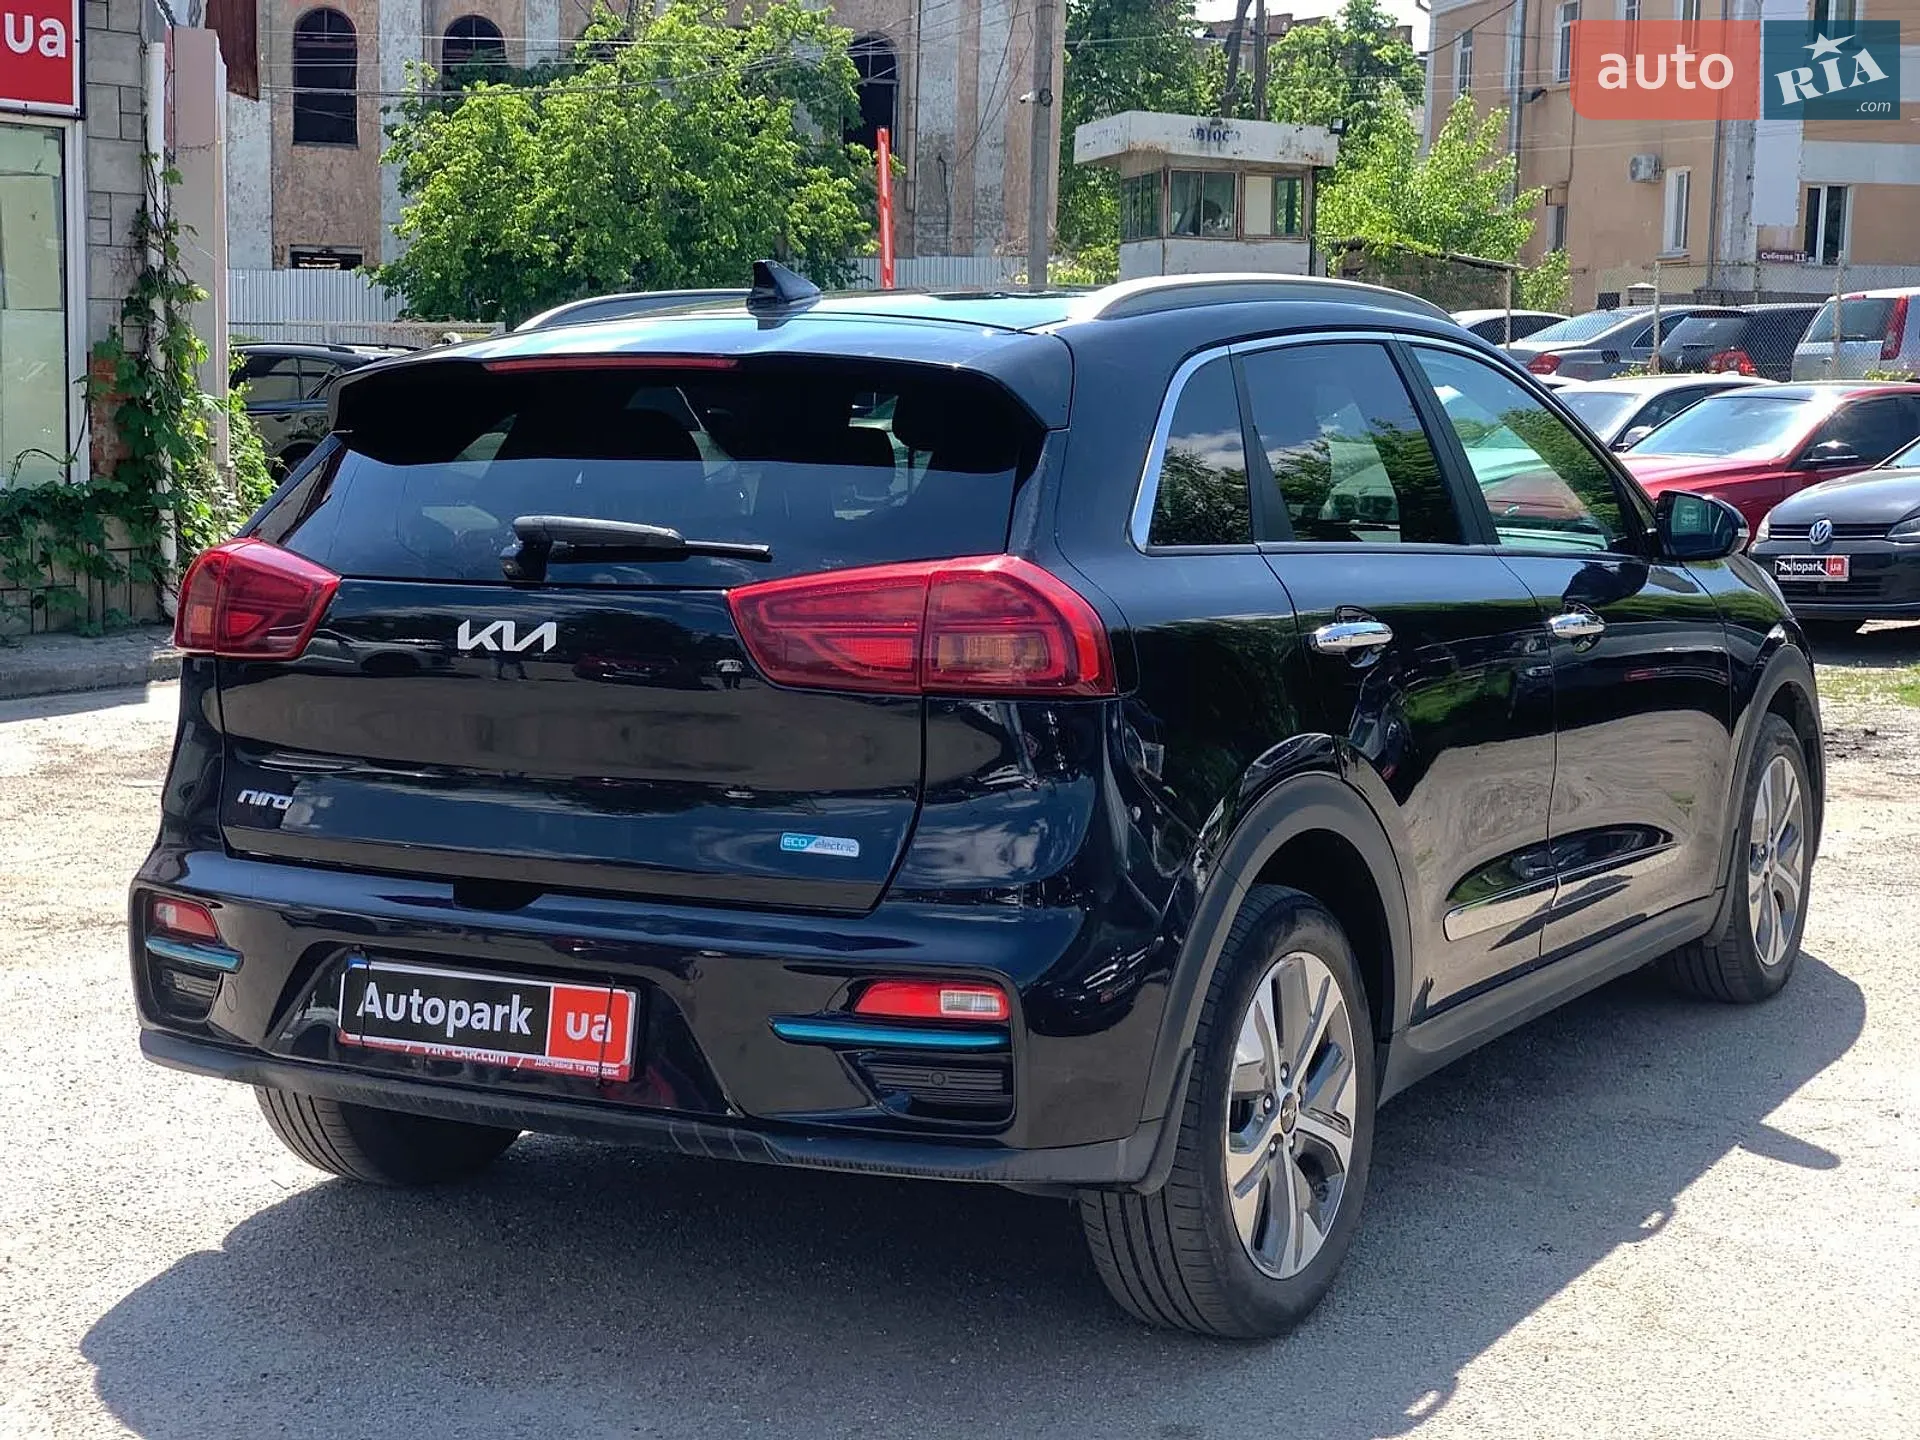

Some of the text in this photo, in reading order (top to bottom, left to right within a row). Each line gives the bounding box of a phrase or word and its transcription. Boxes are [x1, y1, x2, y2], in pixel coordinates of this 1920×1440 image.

[4, 12, 66, 58] ua
[457, 619, 557, 653] KIA
[783, 836, 808, 848] ECO
[356, 981, 613, 1043] Autopark ua
